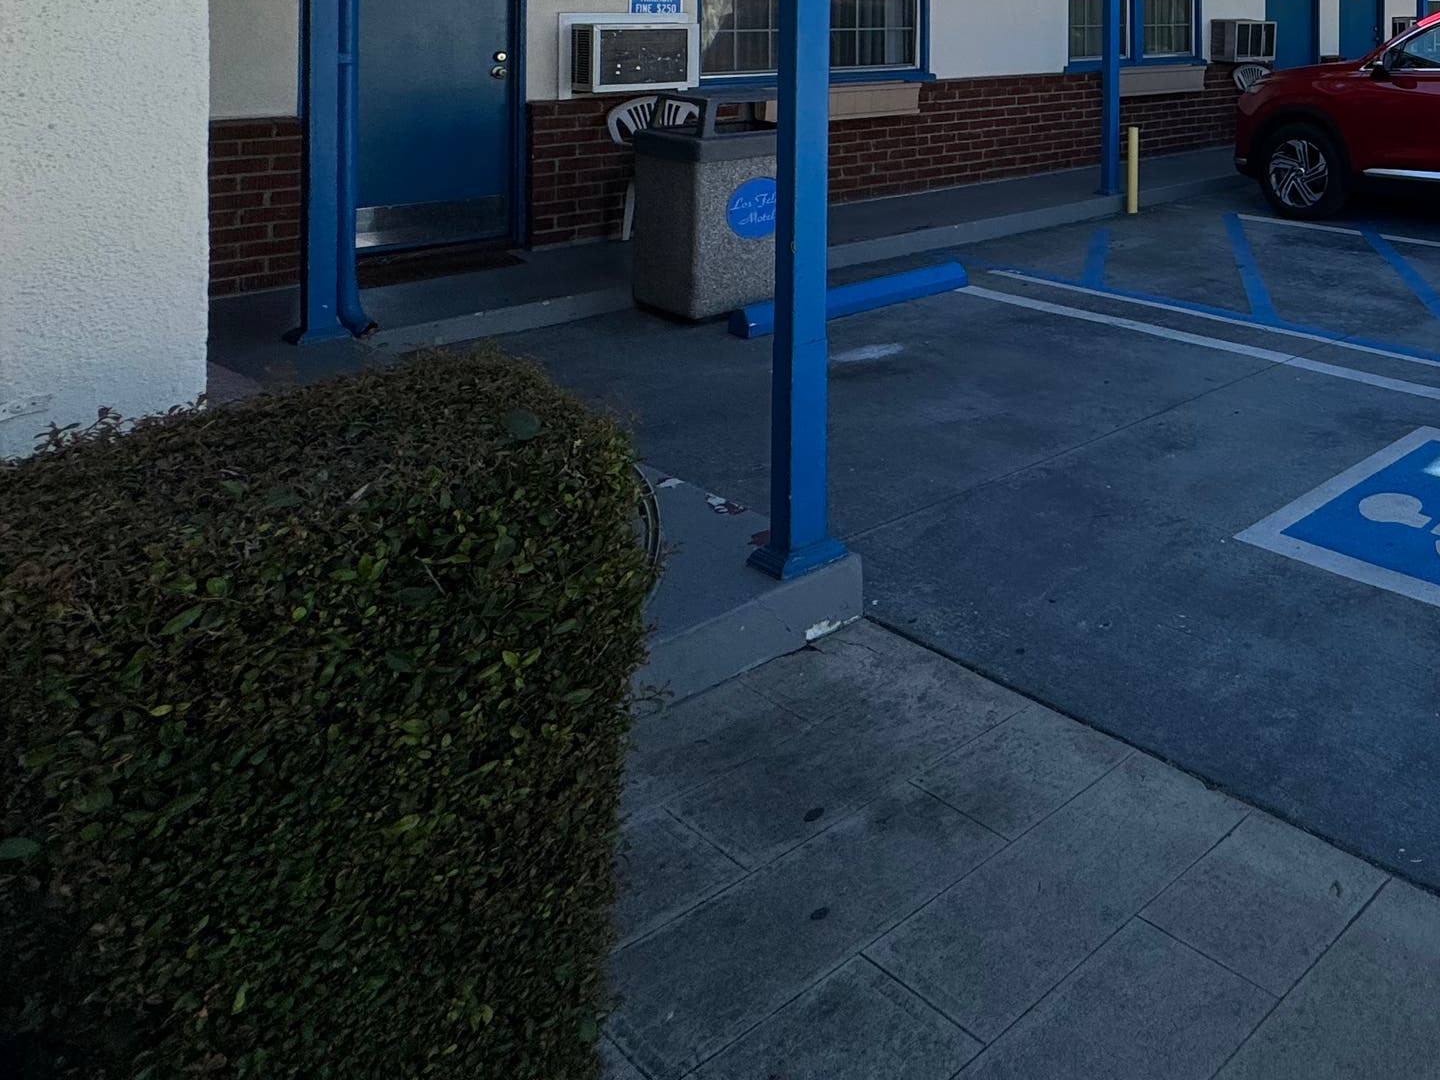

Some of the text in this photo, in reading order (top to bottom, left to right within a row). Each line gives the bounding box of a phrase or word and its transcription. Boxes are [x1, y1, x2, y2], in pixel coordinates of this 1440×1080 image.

[635, 3, 677, 14] FINE $250
[730, 197, 752, 210] Los
